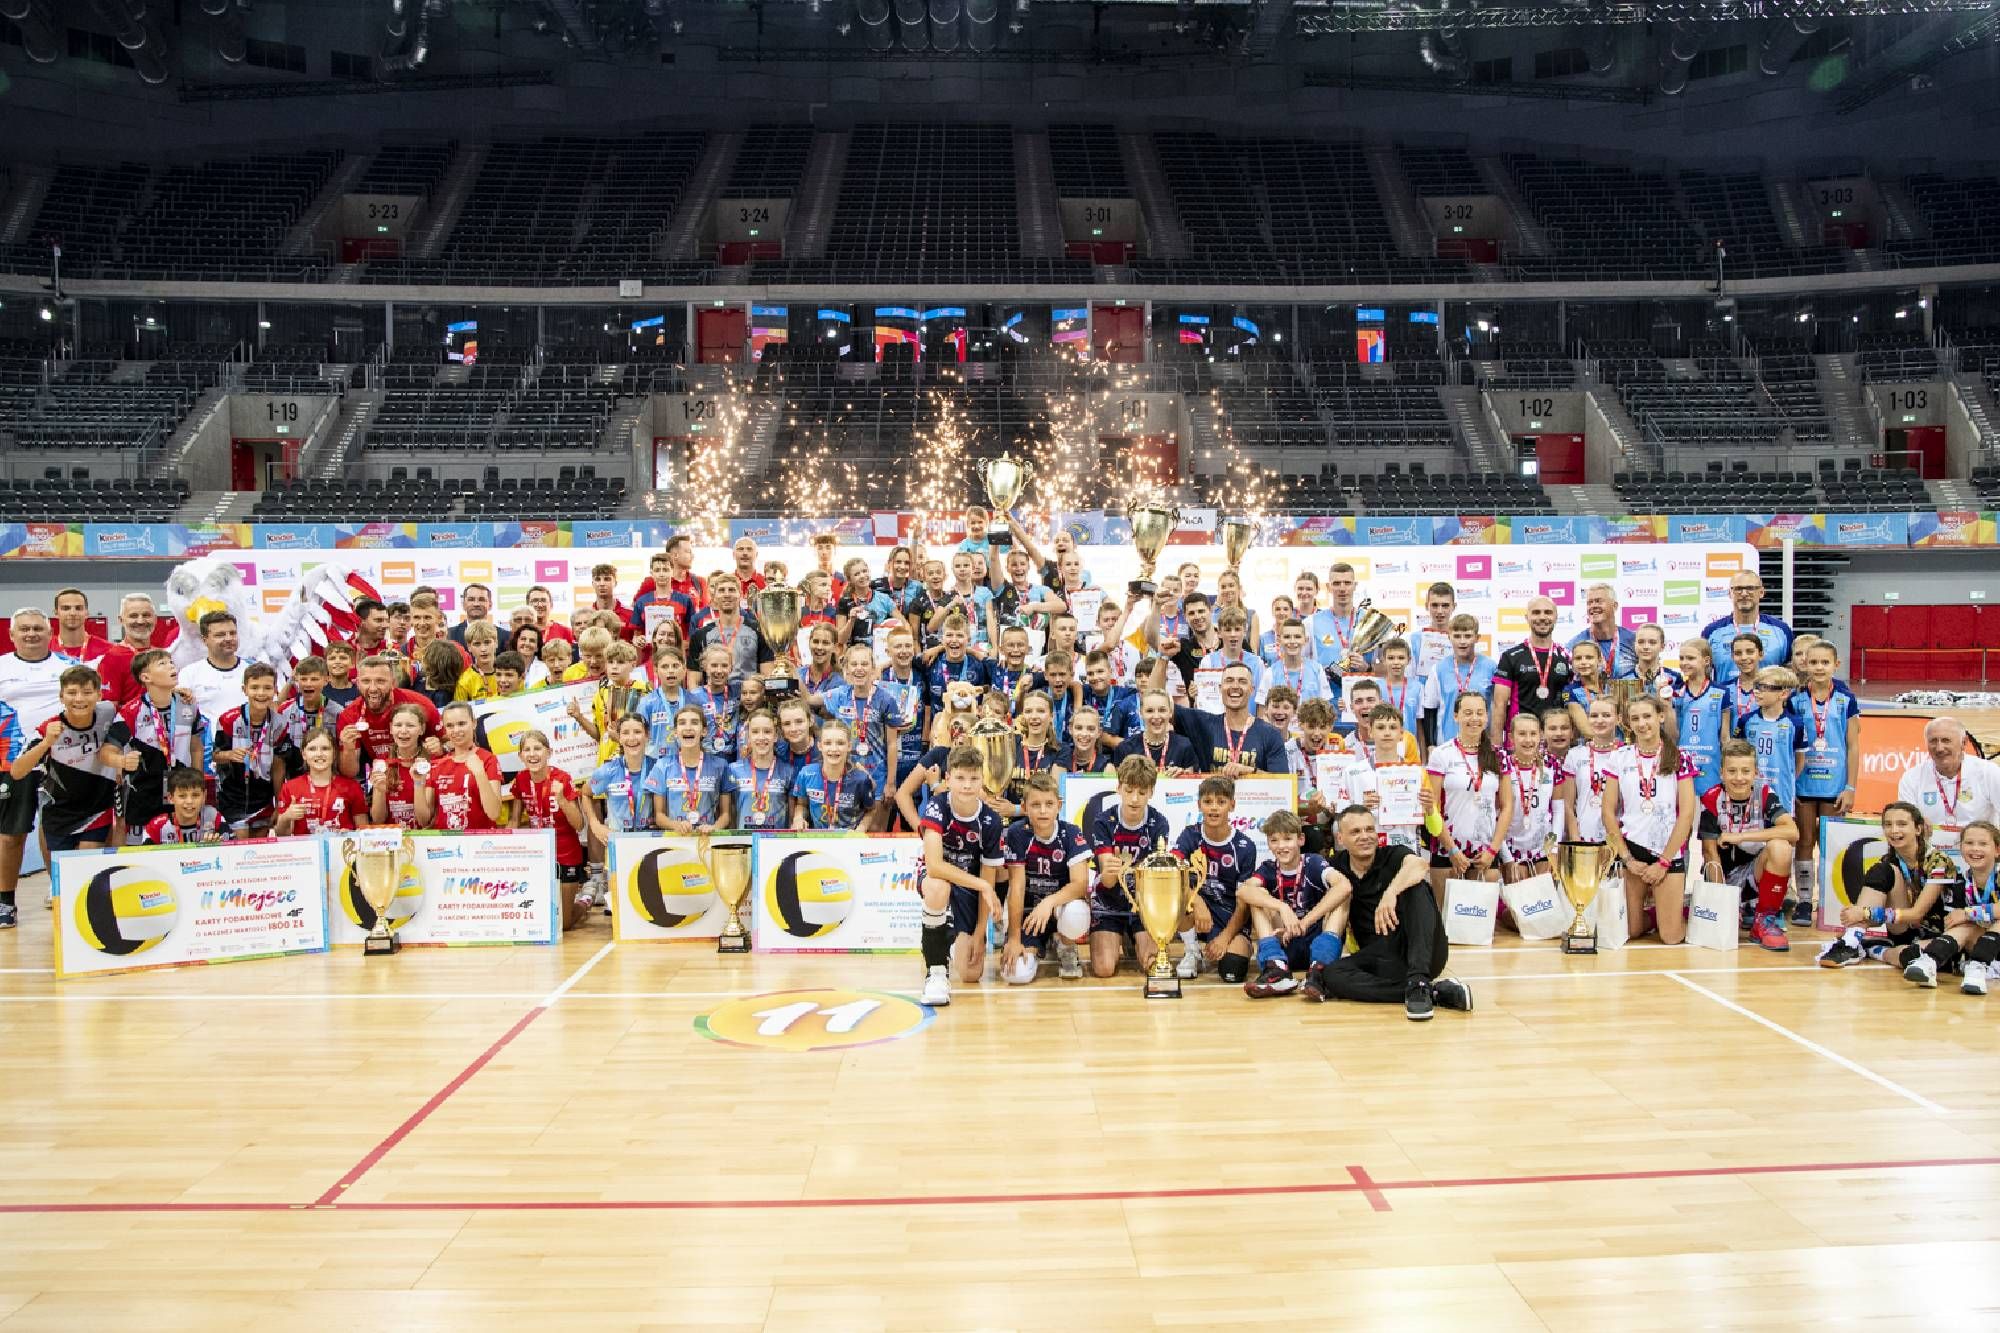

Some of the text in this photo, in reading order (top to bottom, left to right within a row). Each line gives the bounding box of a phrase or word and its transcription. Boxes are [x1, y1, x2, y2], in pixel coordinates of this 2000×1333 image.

[1821, 188, 1853, 205] 3-03
[368, 204, 398, 219] 3-23
[740, 208, 769, 223] 3-24
[1085, 207, 1111, 223] 3-01
[1444, 204, 1474, 220] 3-02
[1520, 398, 1552, 417] 1-02
[1890, 390, 1927, 410] 1-03
[267, 402, 297, 421] 1-19
[683, 401, 715, 419] 1-20
[1691, 714, 1699, 732] 9
[79, 733, 99, 754] 21
[1758, 737, 1772, 756] 99
[1037, 857, 1051, 875] 13
[459, 877, 530, 900] Miejsce
[219, 888, 297, 912] Miejsce
[752, 999, 882, 1036] 11
